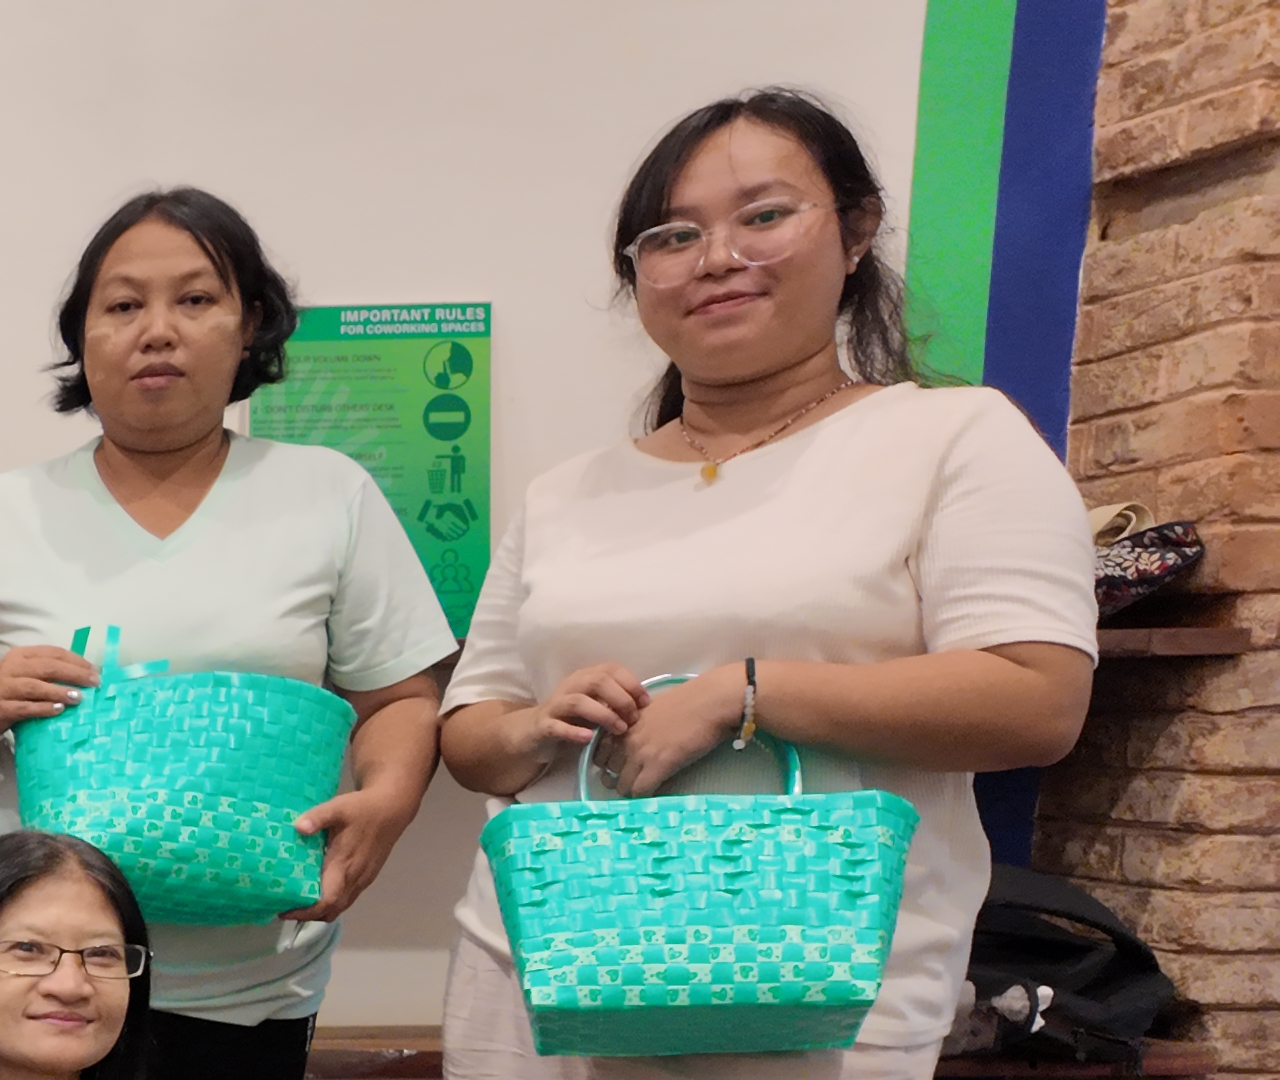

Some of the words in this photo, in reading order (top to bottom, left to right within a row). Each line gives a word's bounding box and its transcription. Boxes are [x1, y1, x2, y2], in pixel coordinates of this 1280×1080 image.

[341, 308, 431, 323] IMPORTANT
[435, 307, 486, 321] RULES
[341, 324, 364, 335] FOR
[366, 322, 438, 335] COWORKING
[441, 321, 486, 333] SPACES
[312, 354, 349, 364] VOLUME
[352, 354, 381, 363] DOWN
[295, 404, 333, 414] DISTURB
[372, 403, 396, 413] DESK
